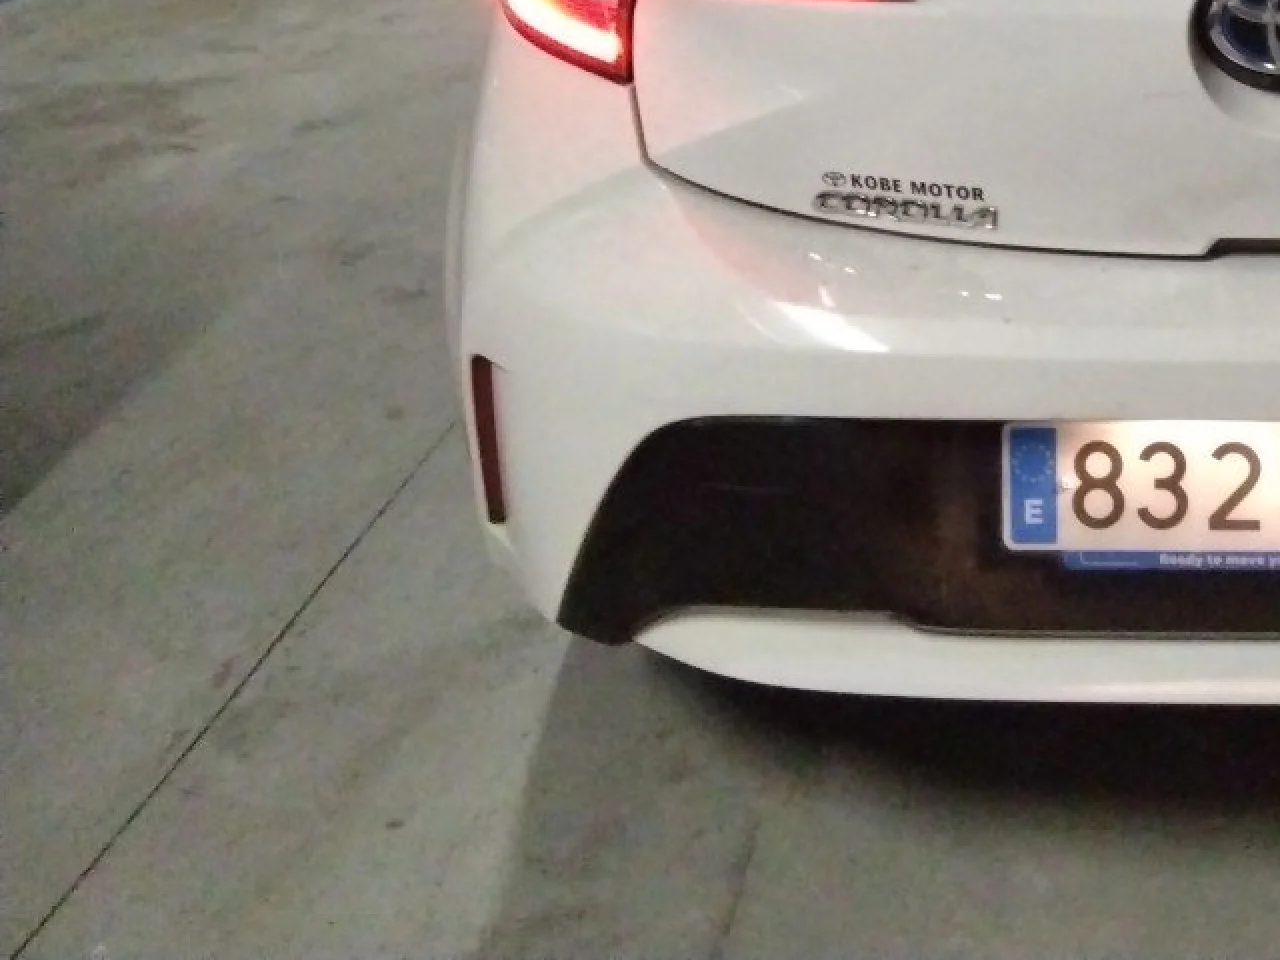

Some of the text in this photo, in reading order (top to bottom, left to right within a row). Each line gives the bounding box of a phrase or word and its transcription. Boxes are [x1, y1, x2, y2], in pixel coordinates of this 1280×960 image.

[850, 173, 985, 202] KOBE MOTOR
[813, 191, 999, 230] COROLLA
[1024, 498, 1044, 525] E
[1159, 553, 1202, 568] Ready
[1206, 553, 1223, 566] to
[1225, 554, 1265, 565] move
